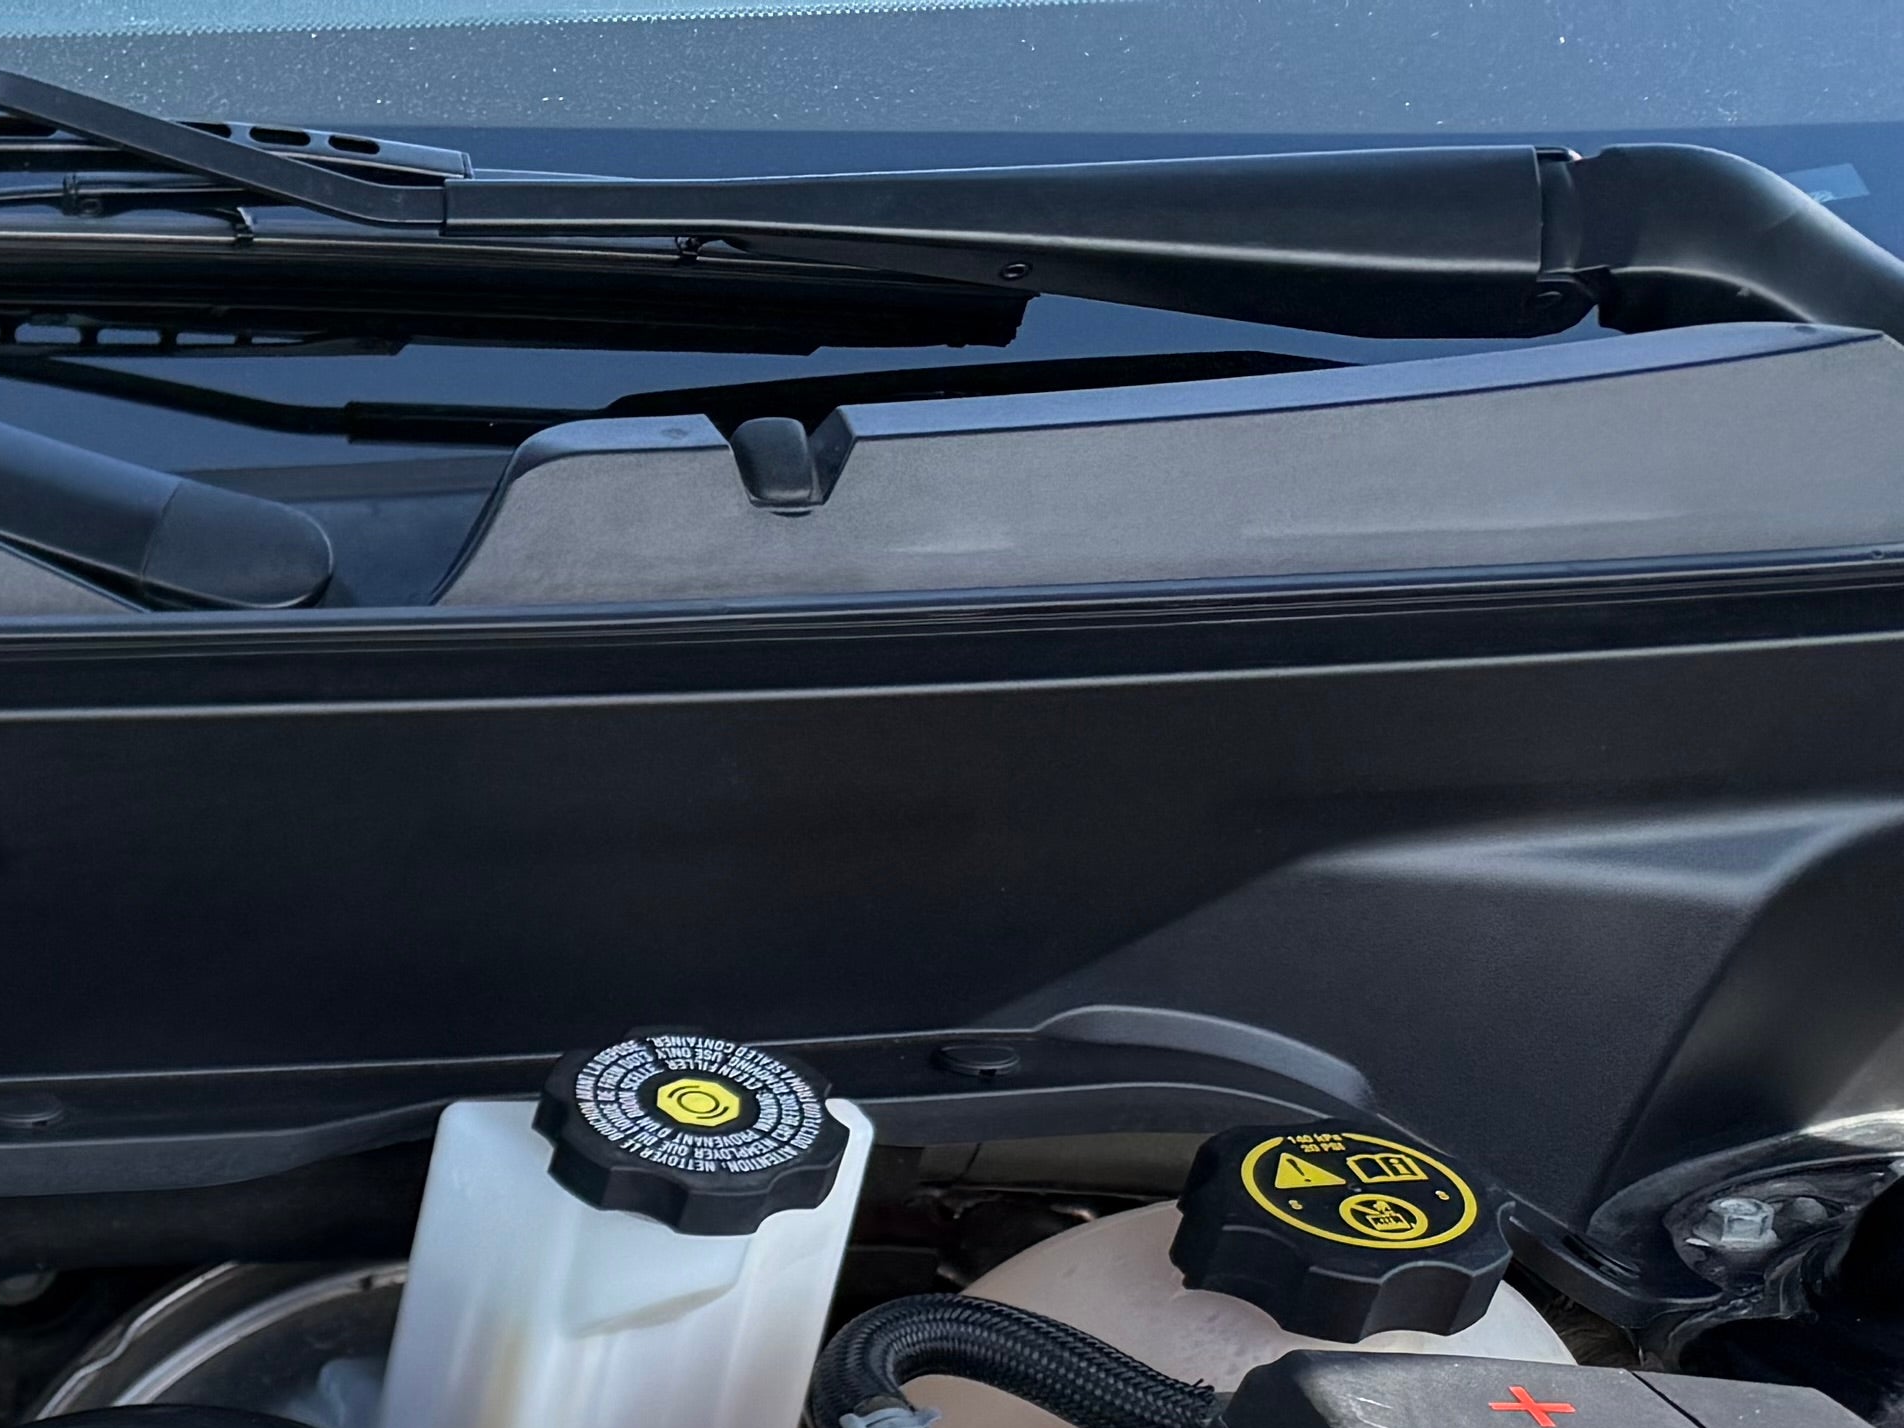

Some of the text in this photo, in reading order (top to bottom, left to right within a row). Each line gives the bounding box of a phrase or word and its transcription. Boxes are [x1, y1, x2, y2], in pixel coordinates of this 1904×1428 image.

[649, 1046, 690, 1059] ONLY
[694, 1047, 724, 1062] USE
[733, 1045, 788, 1074] SEALED
[596, 1063, 629, 1089] FREIN
[660, 1058, 719, 1073] FILLER
[717, 1063, 765, 1090] CLEAN
[573, 1071, 598, 1100] AVANT
[782, 1076, 819, 1102] FROM
[575, 1101, 626, 1143] BOUCHON
[598, 1103, 642, 1135] LIQUIDE
[774, 1093, 801, 1127] BEFORE
[631, 1130, 659, 1147] DU
[632, 1115, 672, 1139] D'UN
[671, 1128, 764, 1149] PROVENANT
[768, 1122, 797, 1143] CAP
[636, 1146, 716, 1174] NETTOYER
[656, 1139, 689, 1158] QUE
[1299, 1144, 1321, 1152] 20
